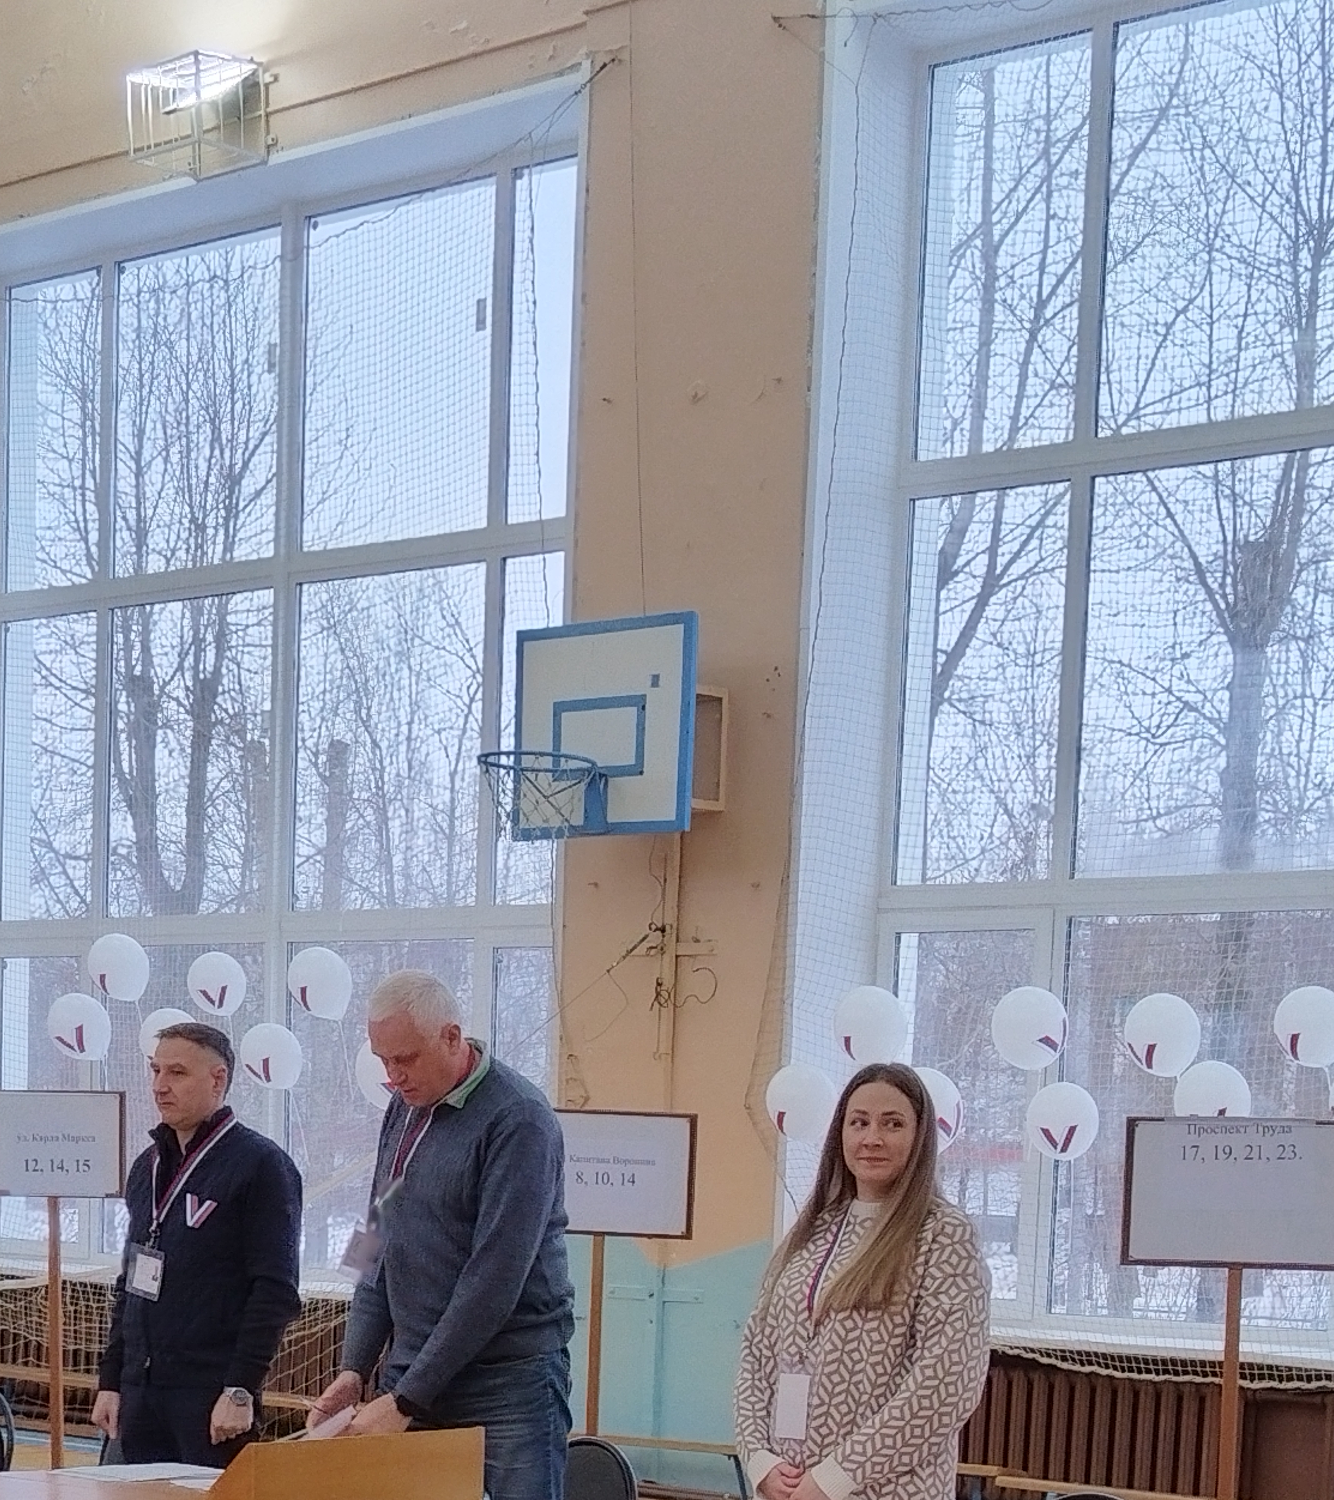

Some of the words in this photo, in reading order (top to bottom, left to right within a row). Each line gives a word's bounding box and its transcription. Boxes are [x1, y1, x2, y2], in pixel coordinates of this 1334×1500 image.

[1186, 1123, 1248, 1138] Проспект
[1253, 1122, 1292, 1137] Труда
[1181, 1144, 1205, 1164] 17,
[1214, 1144, 1238, 1164] 19,
[1243, 1144, 1270, 1163] 21,
[1276, 1144, 1303, 1161] 23.
[24, 1158, 44, 1174] 12,
[49, 1158, 70, 1176] 14,
[75, 1159, 91, 1173] 15
[575, 1171, 588, 1186] 8,
[595, 1171, 614, 1187] 10,
[621, 1172, 636, 1187] 14
